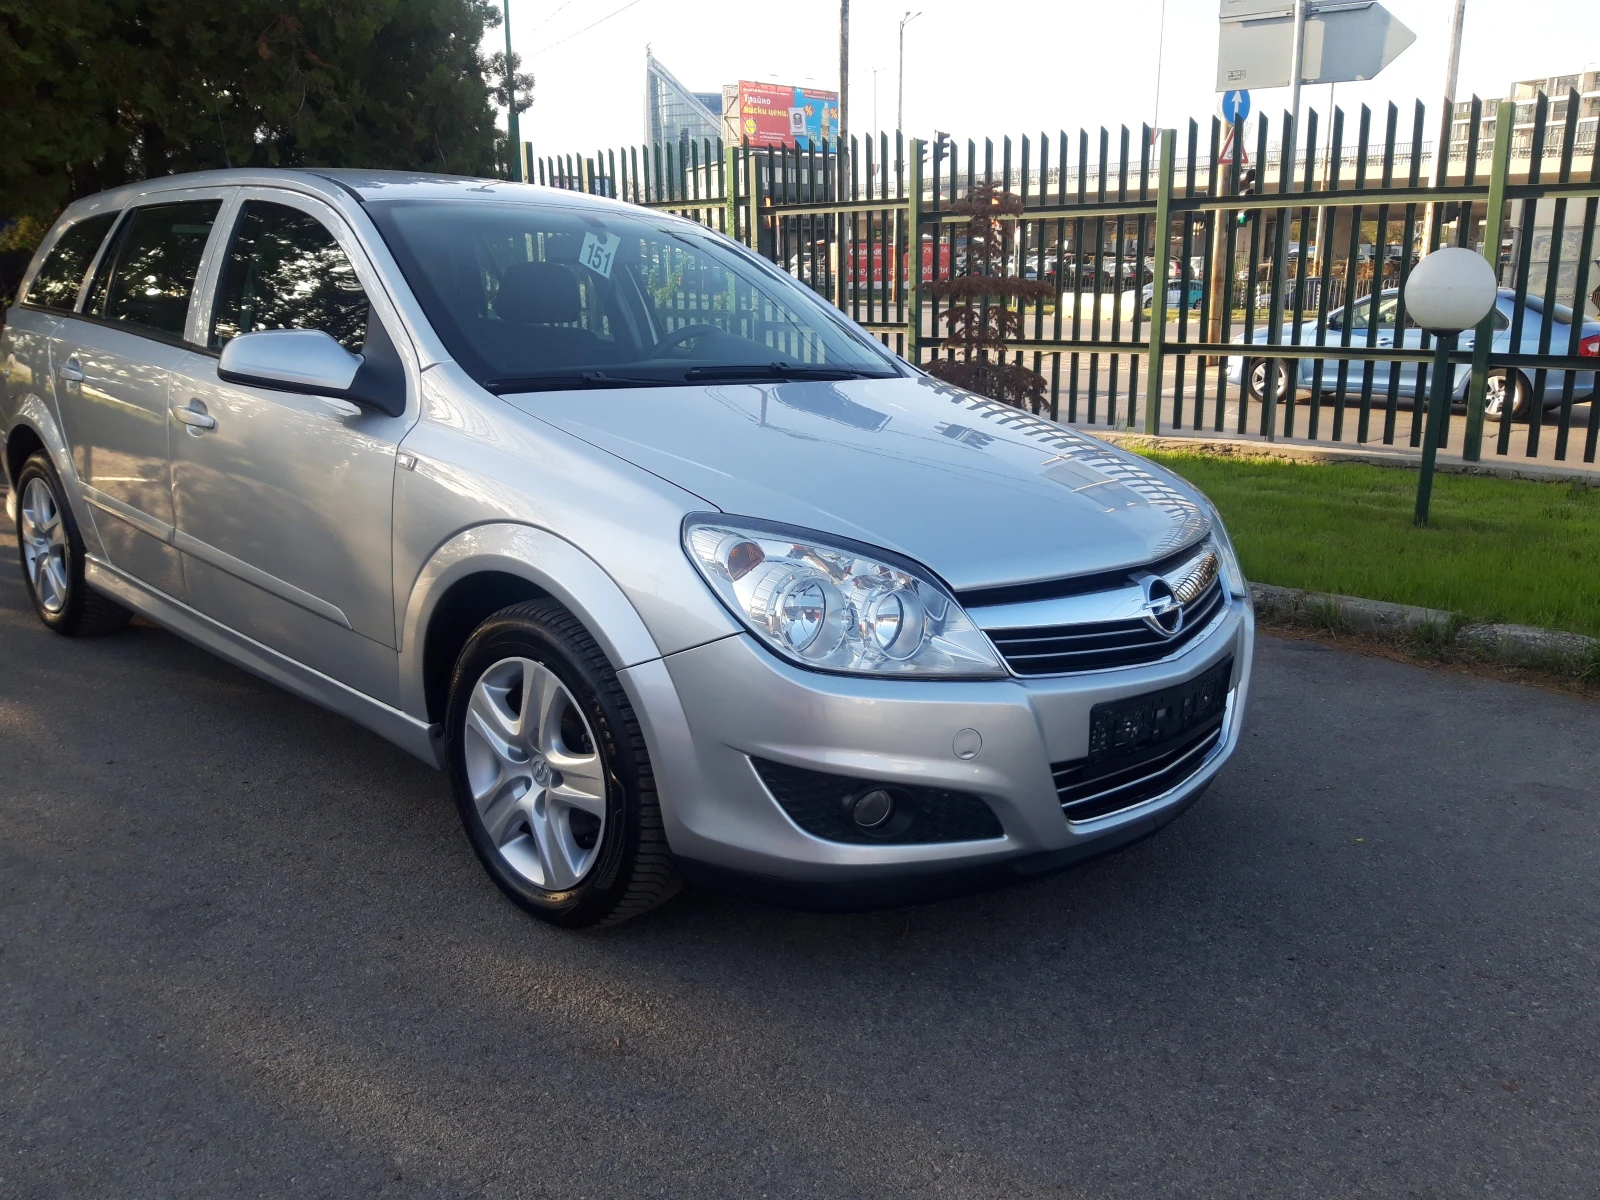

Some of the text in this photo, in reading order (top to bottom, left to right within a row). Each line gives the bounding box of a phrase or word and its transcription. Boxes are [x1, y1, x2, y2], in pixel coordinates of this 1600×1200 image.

[743, 93, 771, 105] Трайно
[743, 105, 789, 117] ниски цени.
[588, 243, 611, 274] 151
